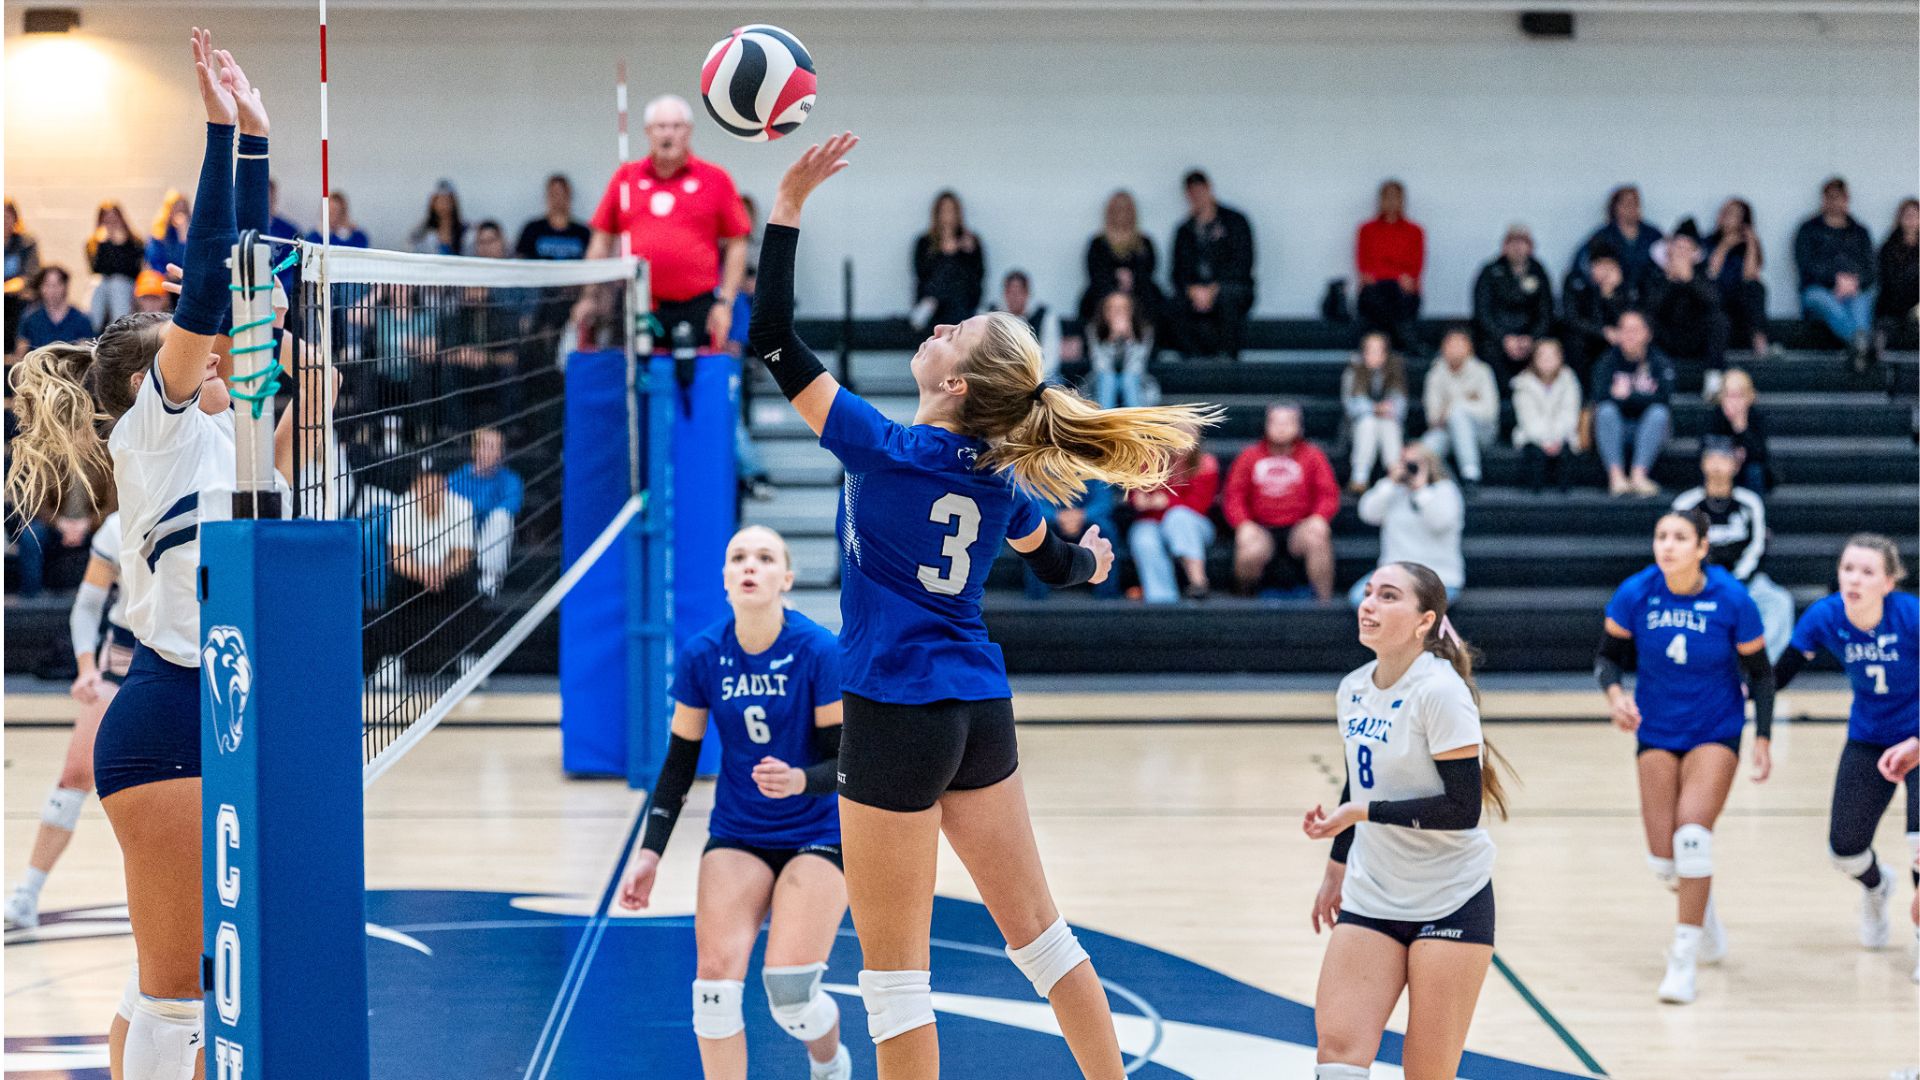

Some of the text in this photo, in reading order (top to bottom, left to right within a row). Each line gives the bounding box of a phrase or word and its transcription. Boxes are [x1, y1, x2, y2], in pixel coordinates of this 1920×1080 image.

[917, 493, 982, 596] 3
[1665, 633, 1688, 665] 4
[721, 673, 789, 700] SAULT
[1865, 664, 1890, 695] 7
[743, 704, 772, 744] 6
[1357, 744, 1375, 790] 8
